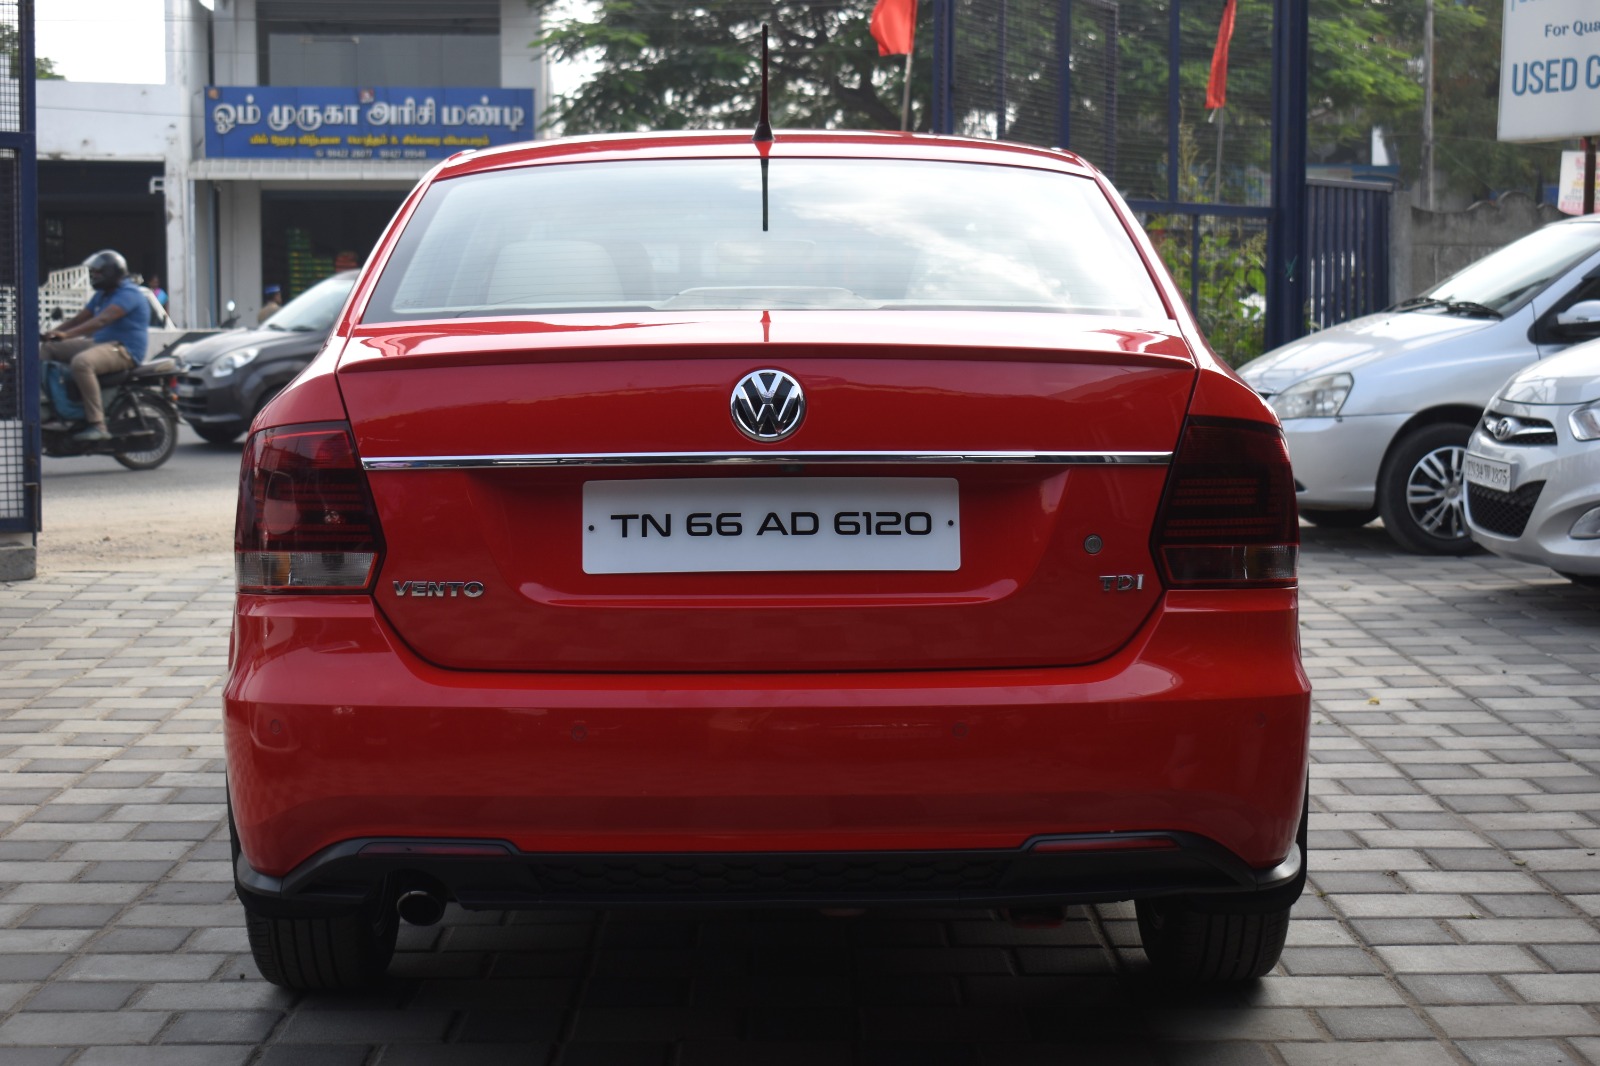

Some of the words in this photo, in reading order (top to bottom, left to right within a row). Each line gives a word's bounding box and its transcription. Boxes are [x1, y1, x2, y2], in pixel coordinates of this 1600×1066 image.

[1544, 24, 1570, 38] For
[1511, 57, 1578, 97] USED
[213, 94, 261, 134] ஓம்
[267, 104, 360, 131] முருகா
[367, 97, 436, 125] அரிசி
[442, 95, 525, 131] மண்டி
[610, 514, 672, 538] TN
[685, 512, 743, 537] 66
[756, 511, 820, 536] AD
[833, 511, 932, 536] 6120
[392, 580, 485, 598] VENTO
[1098, 573, 1144, 592] TDI
